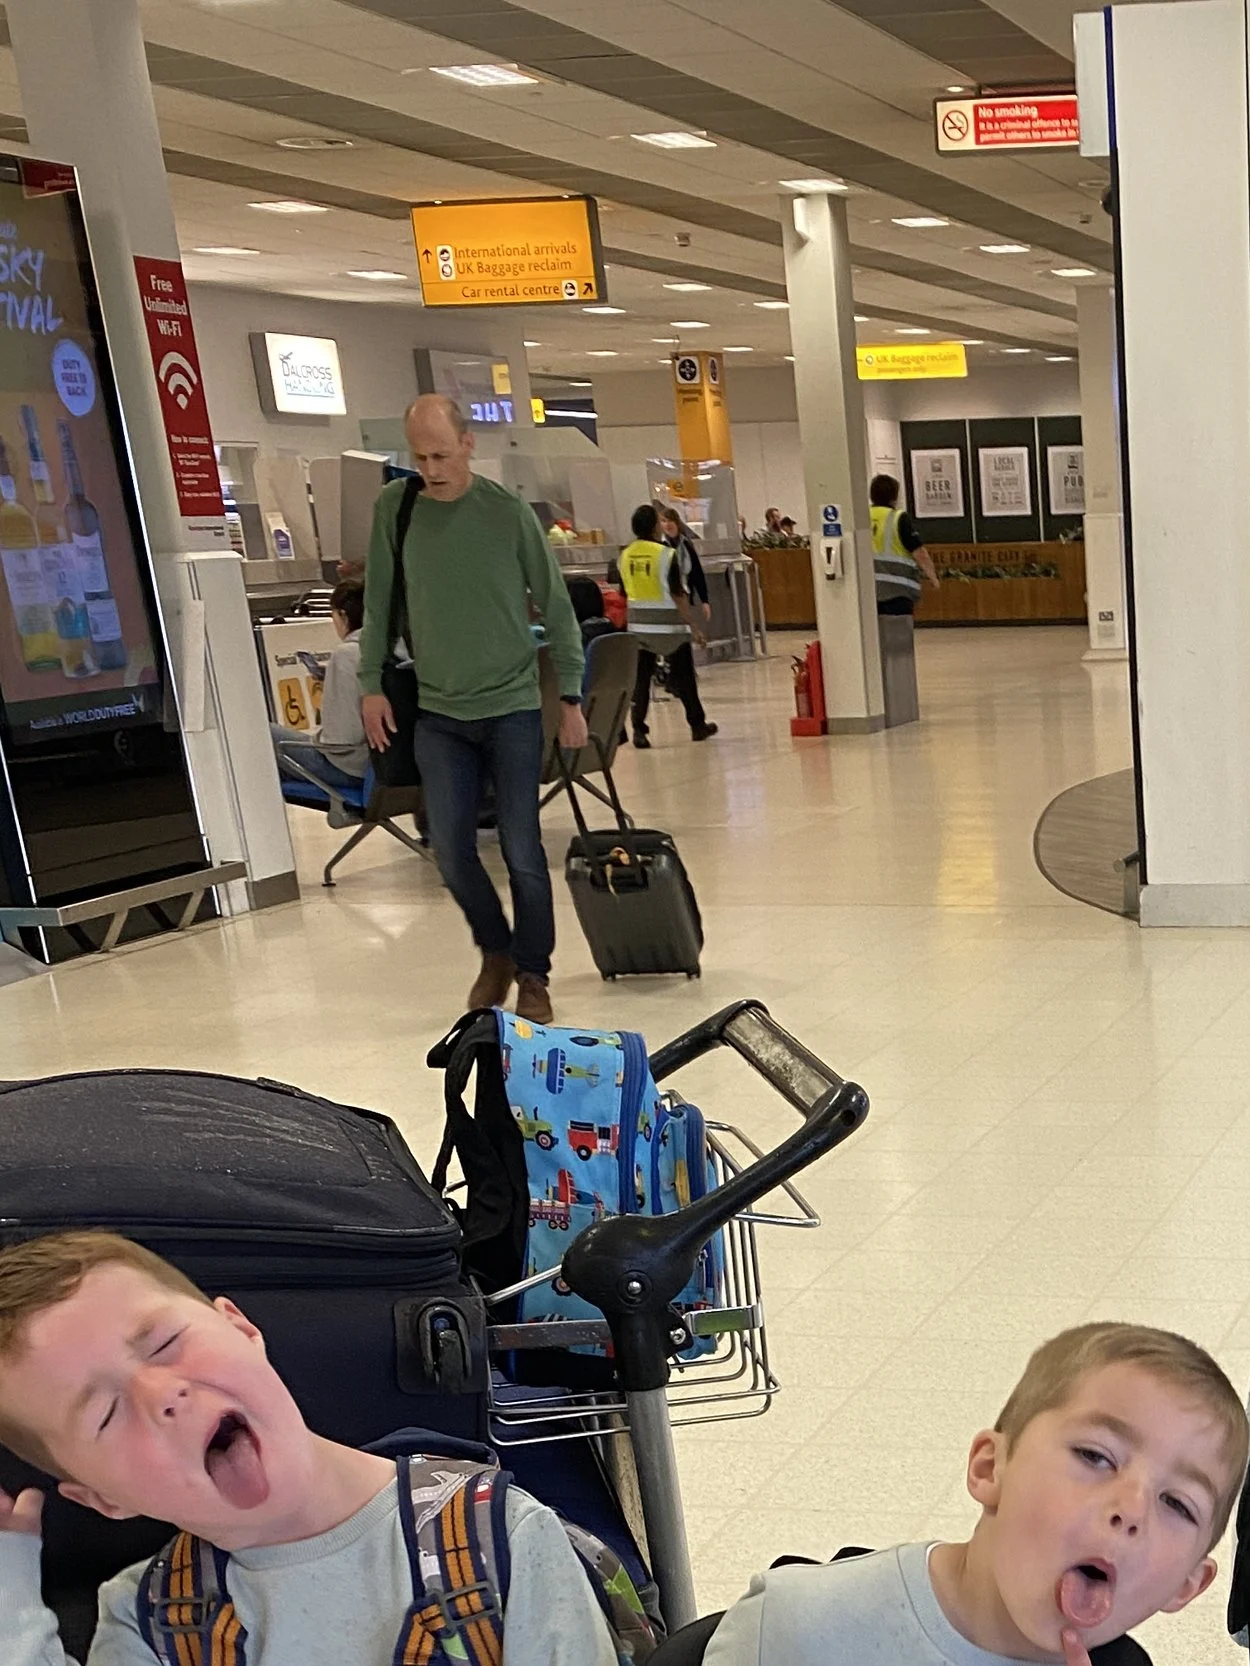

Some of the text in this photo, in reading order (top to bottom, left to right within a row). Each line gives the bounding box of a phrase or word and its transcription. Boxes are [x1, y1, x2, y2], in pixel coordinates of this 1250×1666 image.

[978, 104, 1038, 118] No smoking
[1000, 119, 1031, 130] criminal
[1032, 118, 1061, 129] offence
[1061, 118, 1071, 128] to
[980, 131, 1005, 143] permit
[1005, 131, 1032, 140] others
[1032, 130, 1041, 139] to
[1041, 128, 1067, 139] smoke
[454, 241, 577, 259] International arrivals
[456, 258, 573, 277] UK Baggage reclaim
[150, 274, 173, 293] Free
[461, 284, 561, 298] Car rental centre
[143, 295, 188, 316] Unlimited
[156, 319, 182, 337] Wi-Fi
[876, 352, 959, 365] UK Baggage reclaim
[281, 360, 332, 381] DALCROSS
[925, 480, 951, 492] BEER
